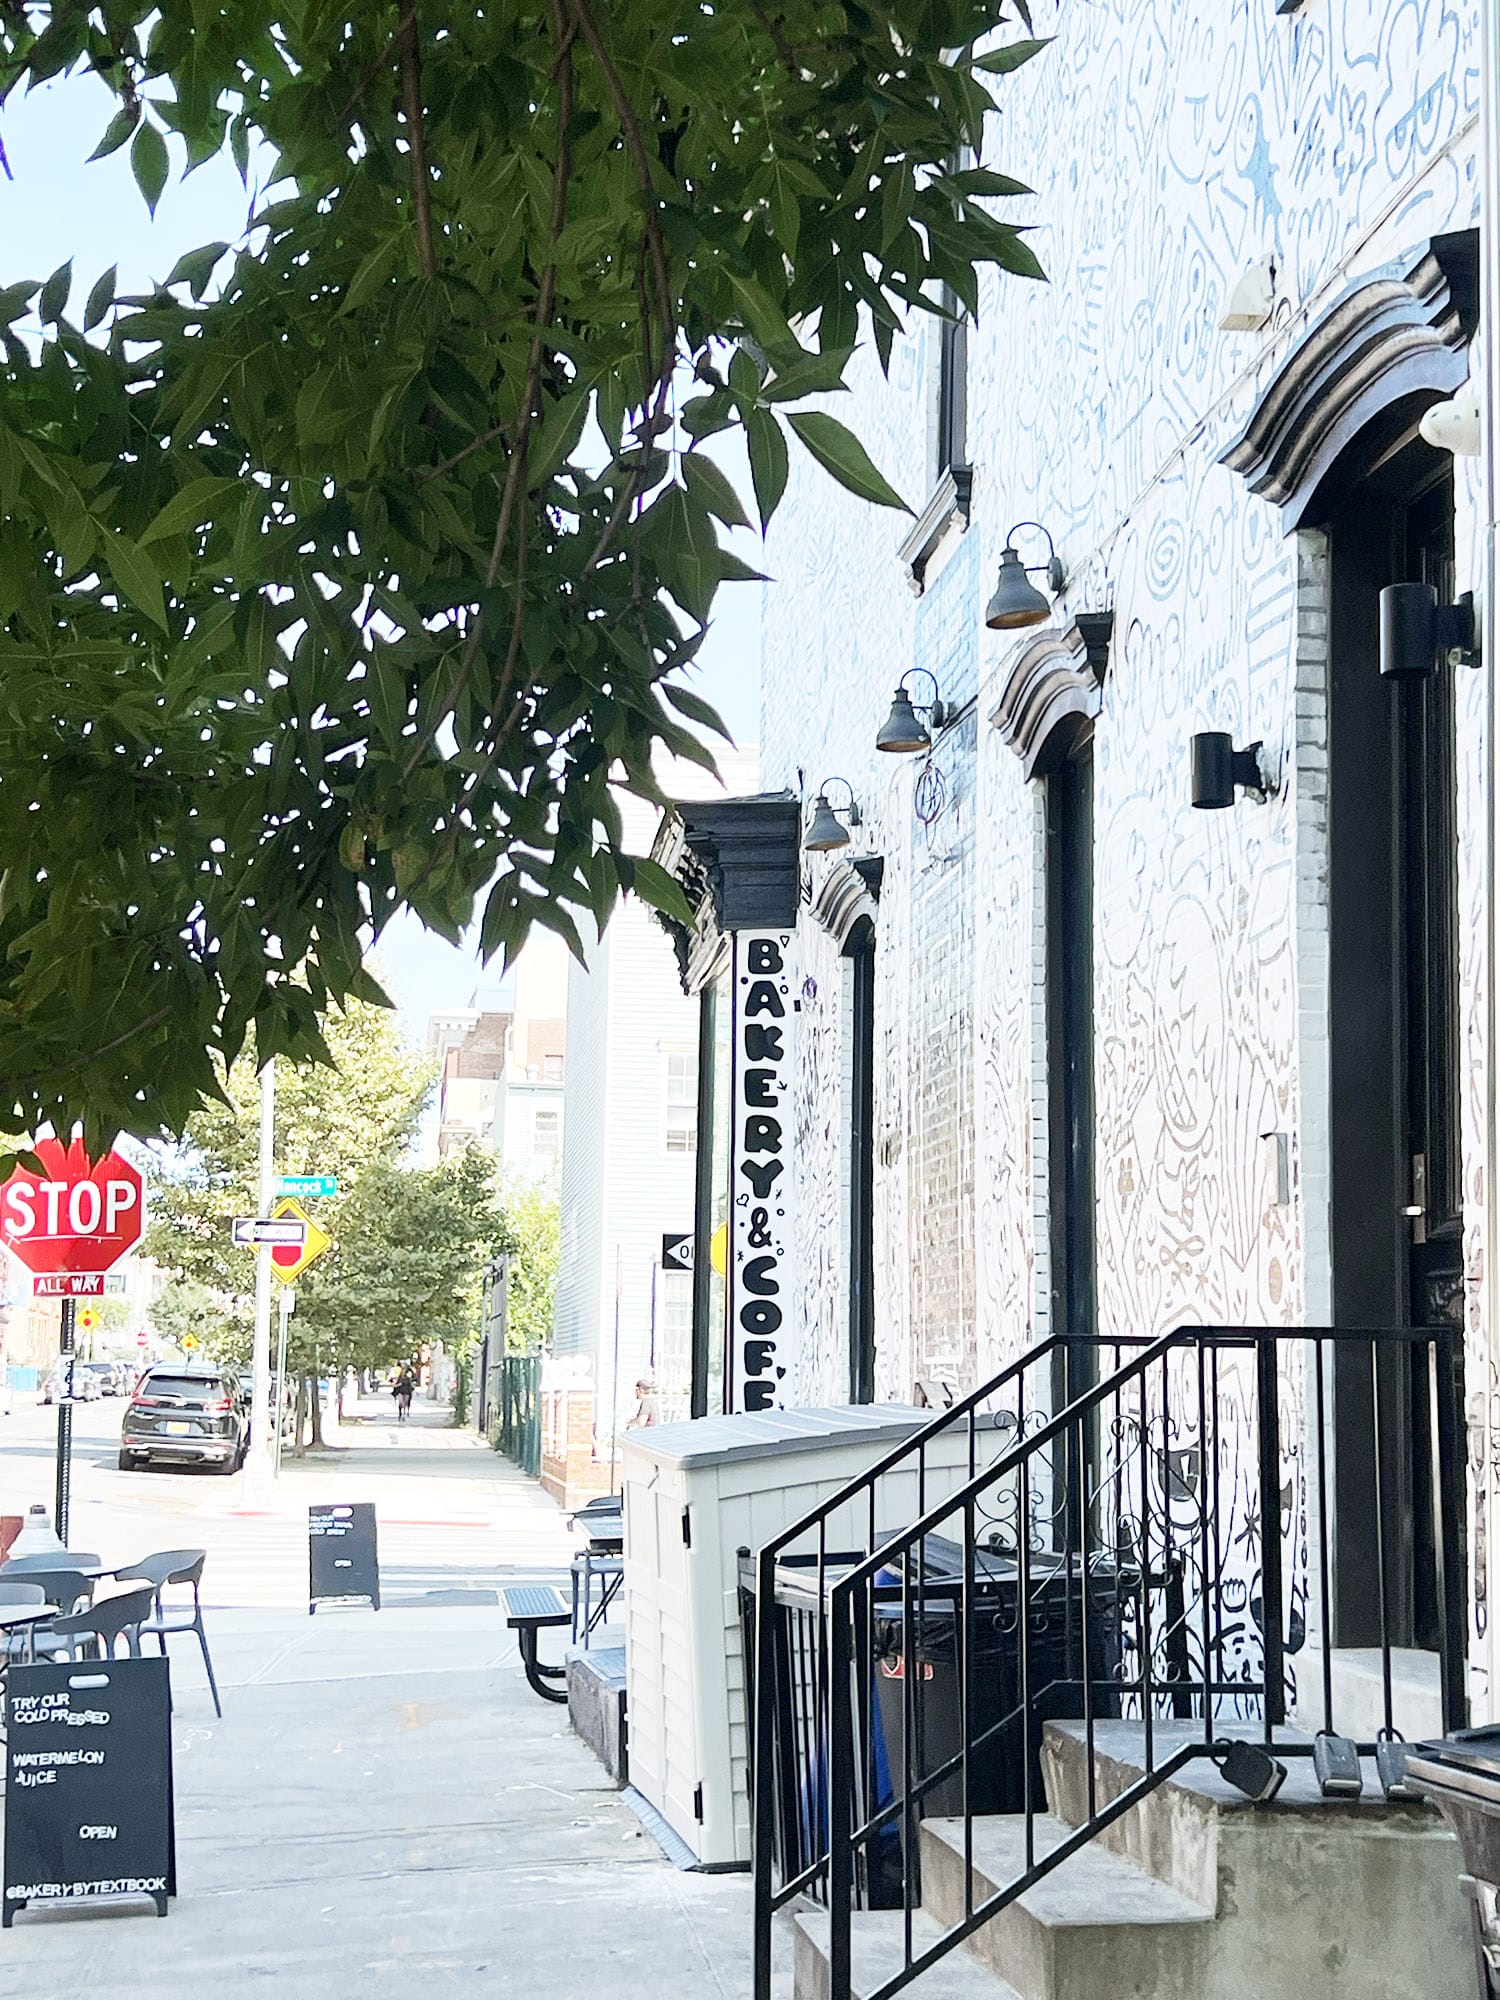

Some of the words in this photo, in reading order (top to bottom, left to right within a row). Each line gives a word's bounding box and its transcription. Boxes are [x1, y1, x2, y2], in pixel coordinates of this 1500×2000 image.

[740, 938, 785, 1199] BAKERY
[4, 1180, 137, 1237] STOP
[748, 1206, 772, 1248] &
[37, 1277, 65, 1294] ALL
[71, 1276, 101, 1293] WAY
[11, 1696, 41, 1710] TRY
[41, 1693, 70, 1707] OUR
[14, 1709, 50, 1724] COLD
[50, 1709, 110, 1726] PRESSED
[13, 1749, 105, 1767] WATERMELON
[15, 1770, 57, 1787] JUICE
[79, 1825, 118, 1839] OPEN
